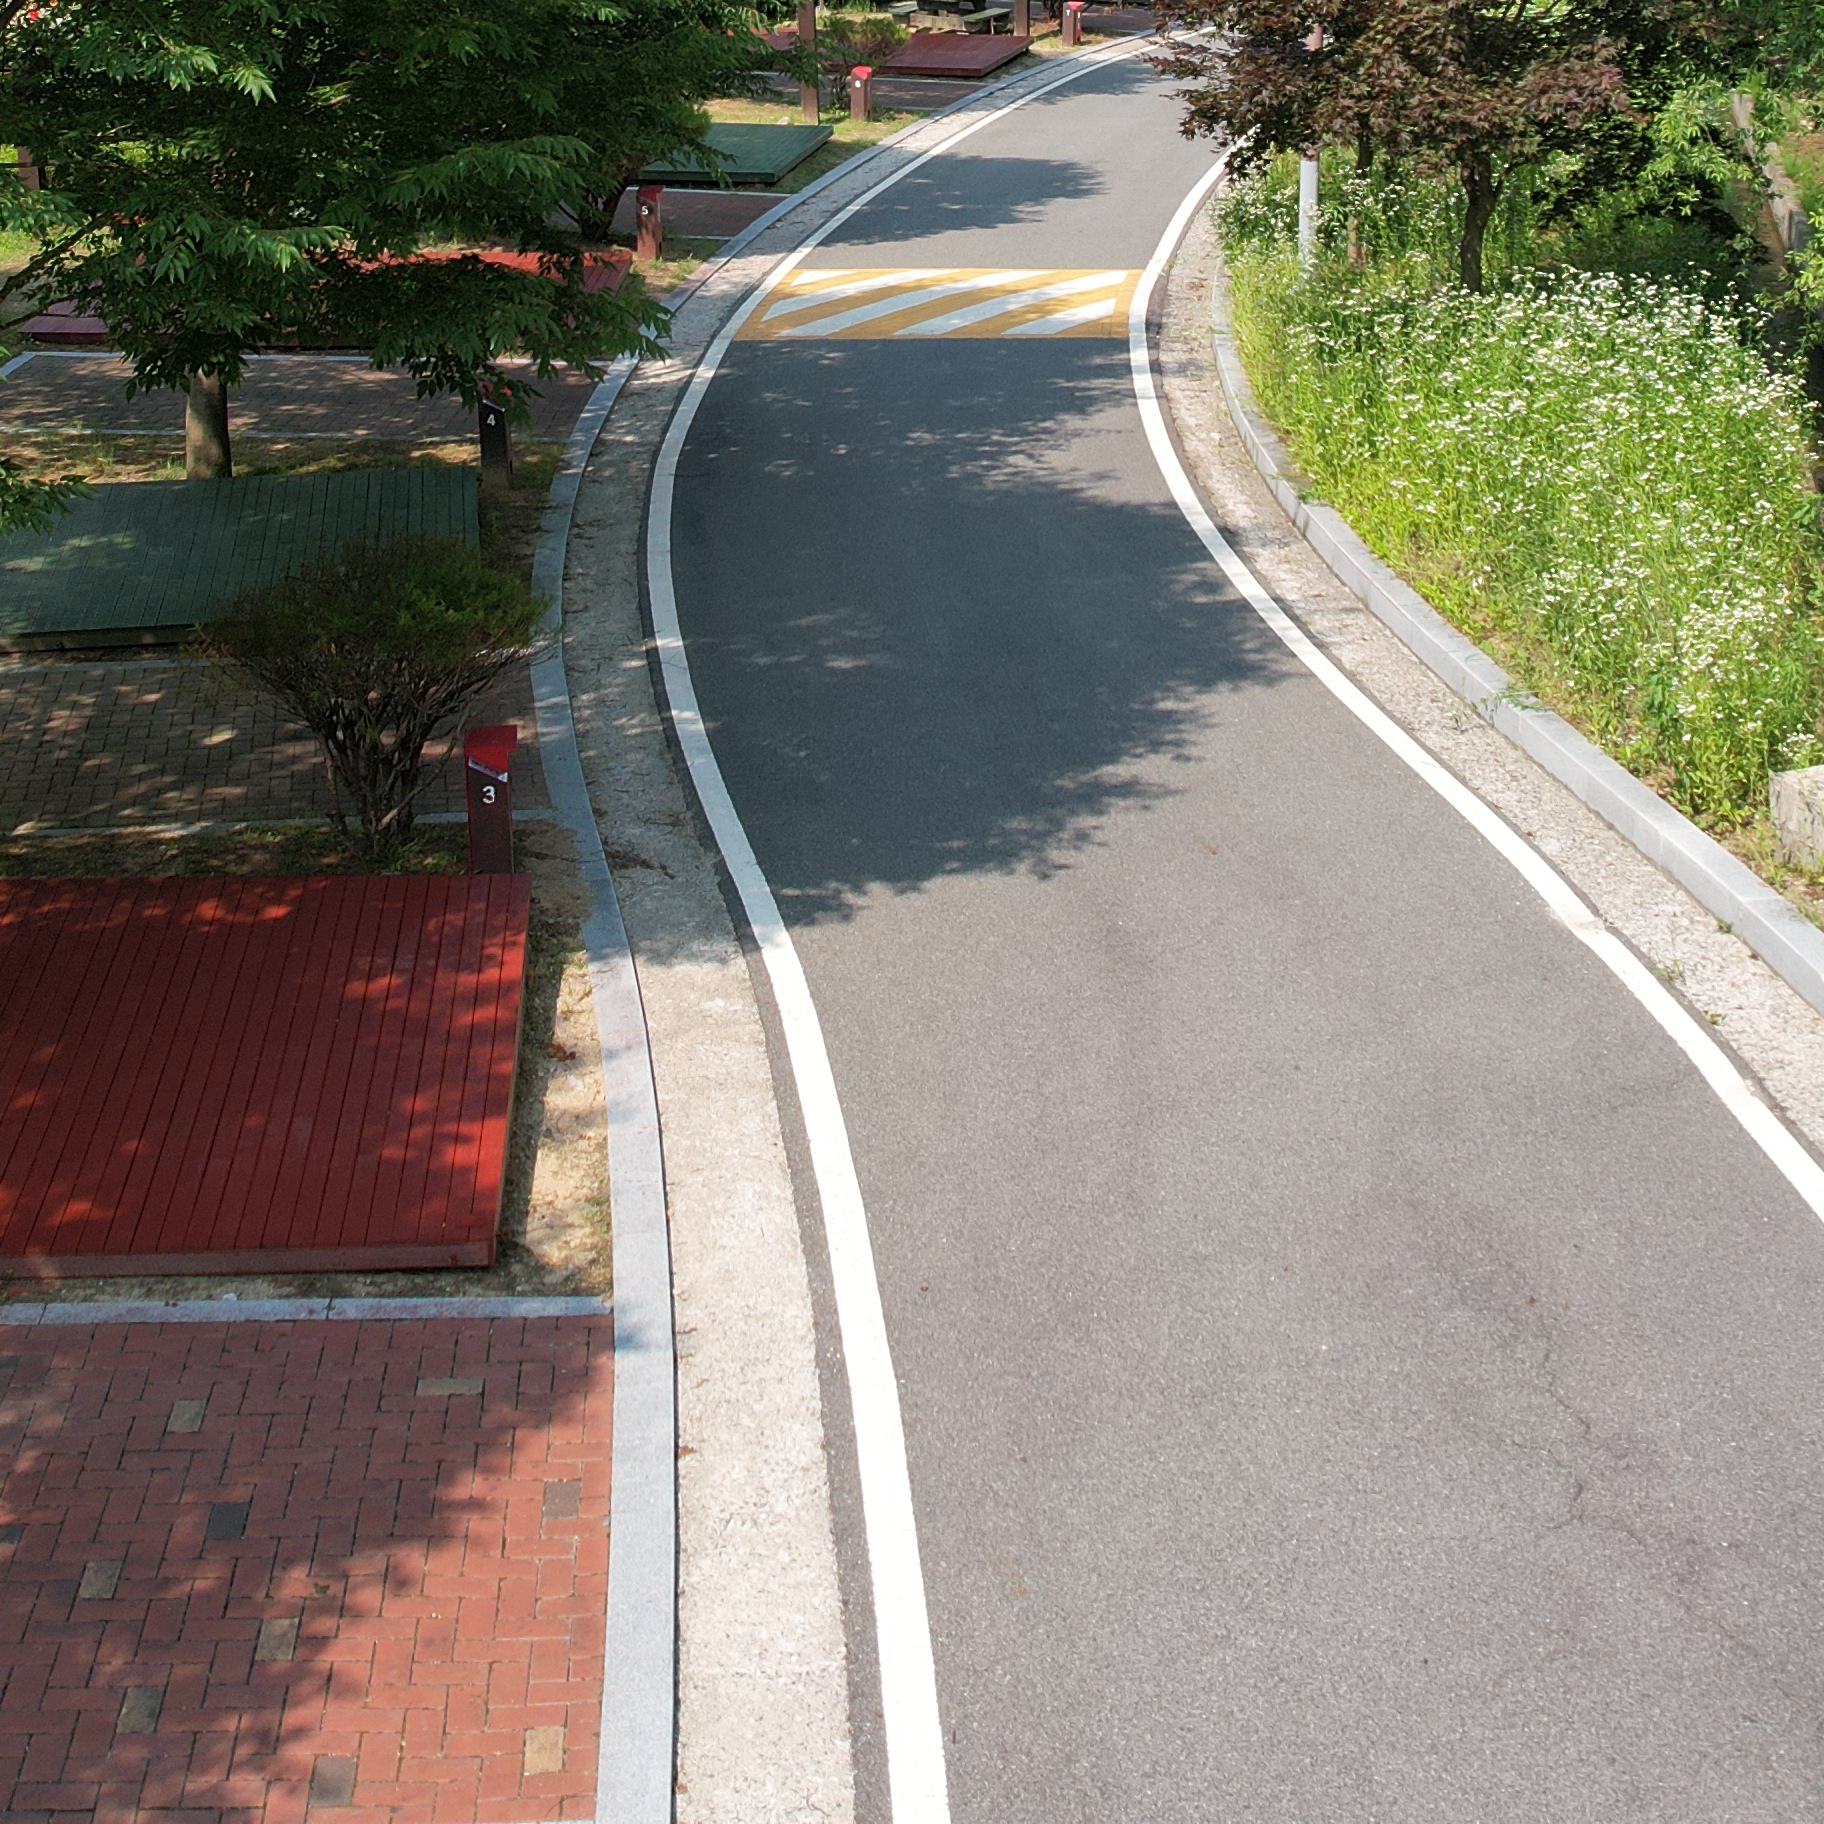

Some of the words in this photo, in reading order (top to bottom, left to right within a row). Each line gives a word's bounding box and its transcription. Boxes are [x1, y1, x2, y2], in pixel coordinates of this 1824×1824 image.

[641, 205, 649, 215] 5
[486, 413, 496, 426] 4
[482, 785, 496, 804] 3
